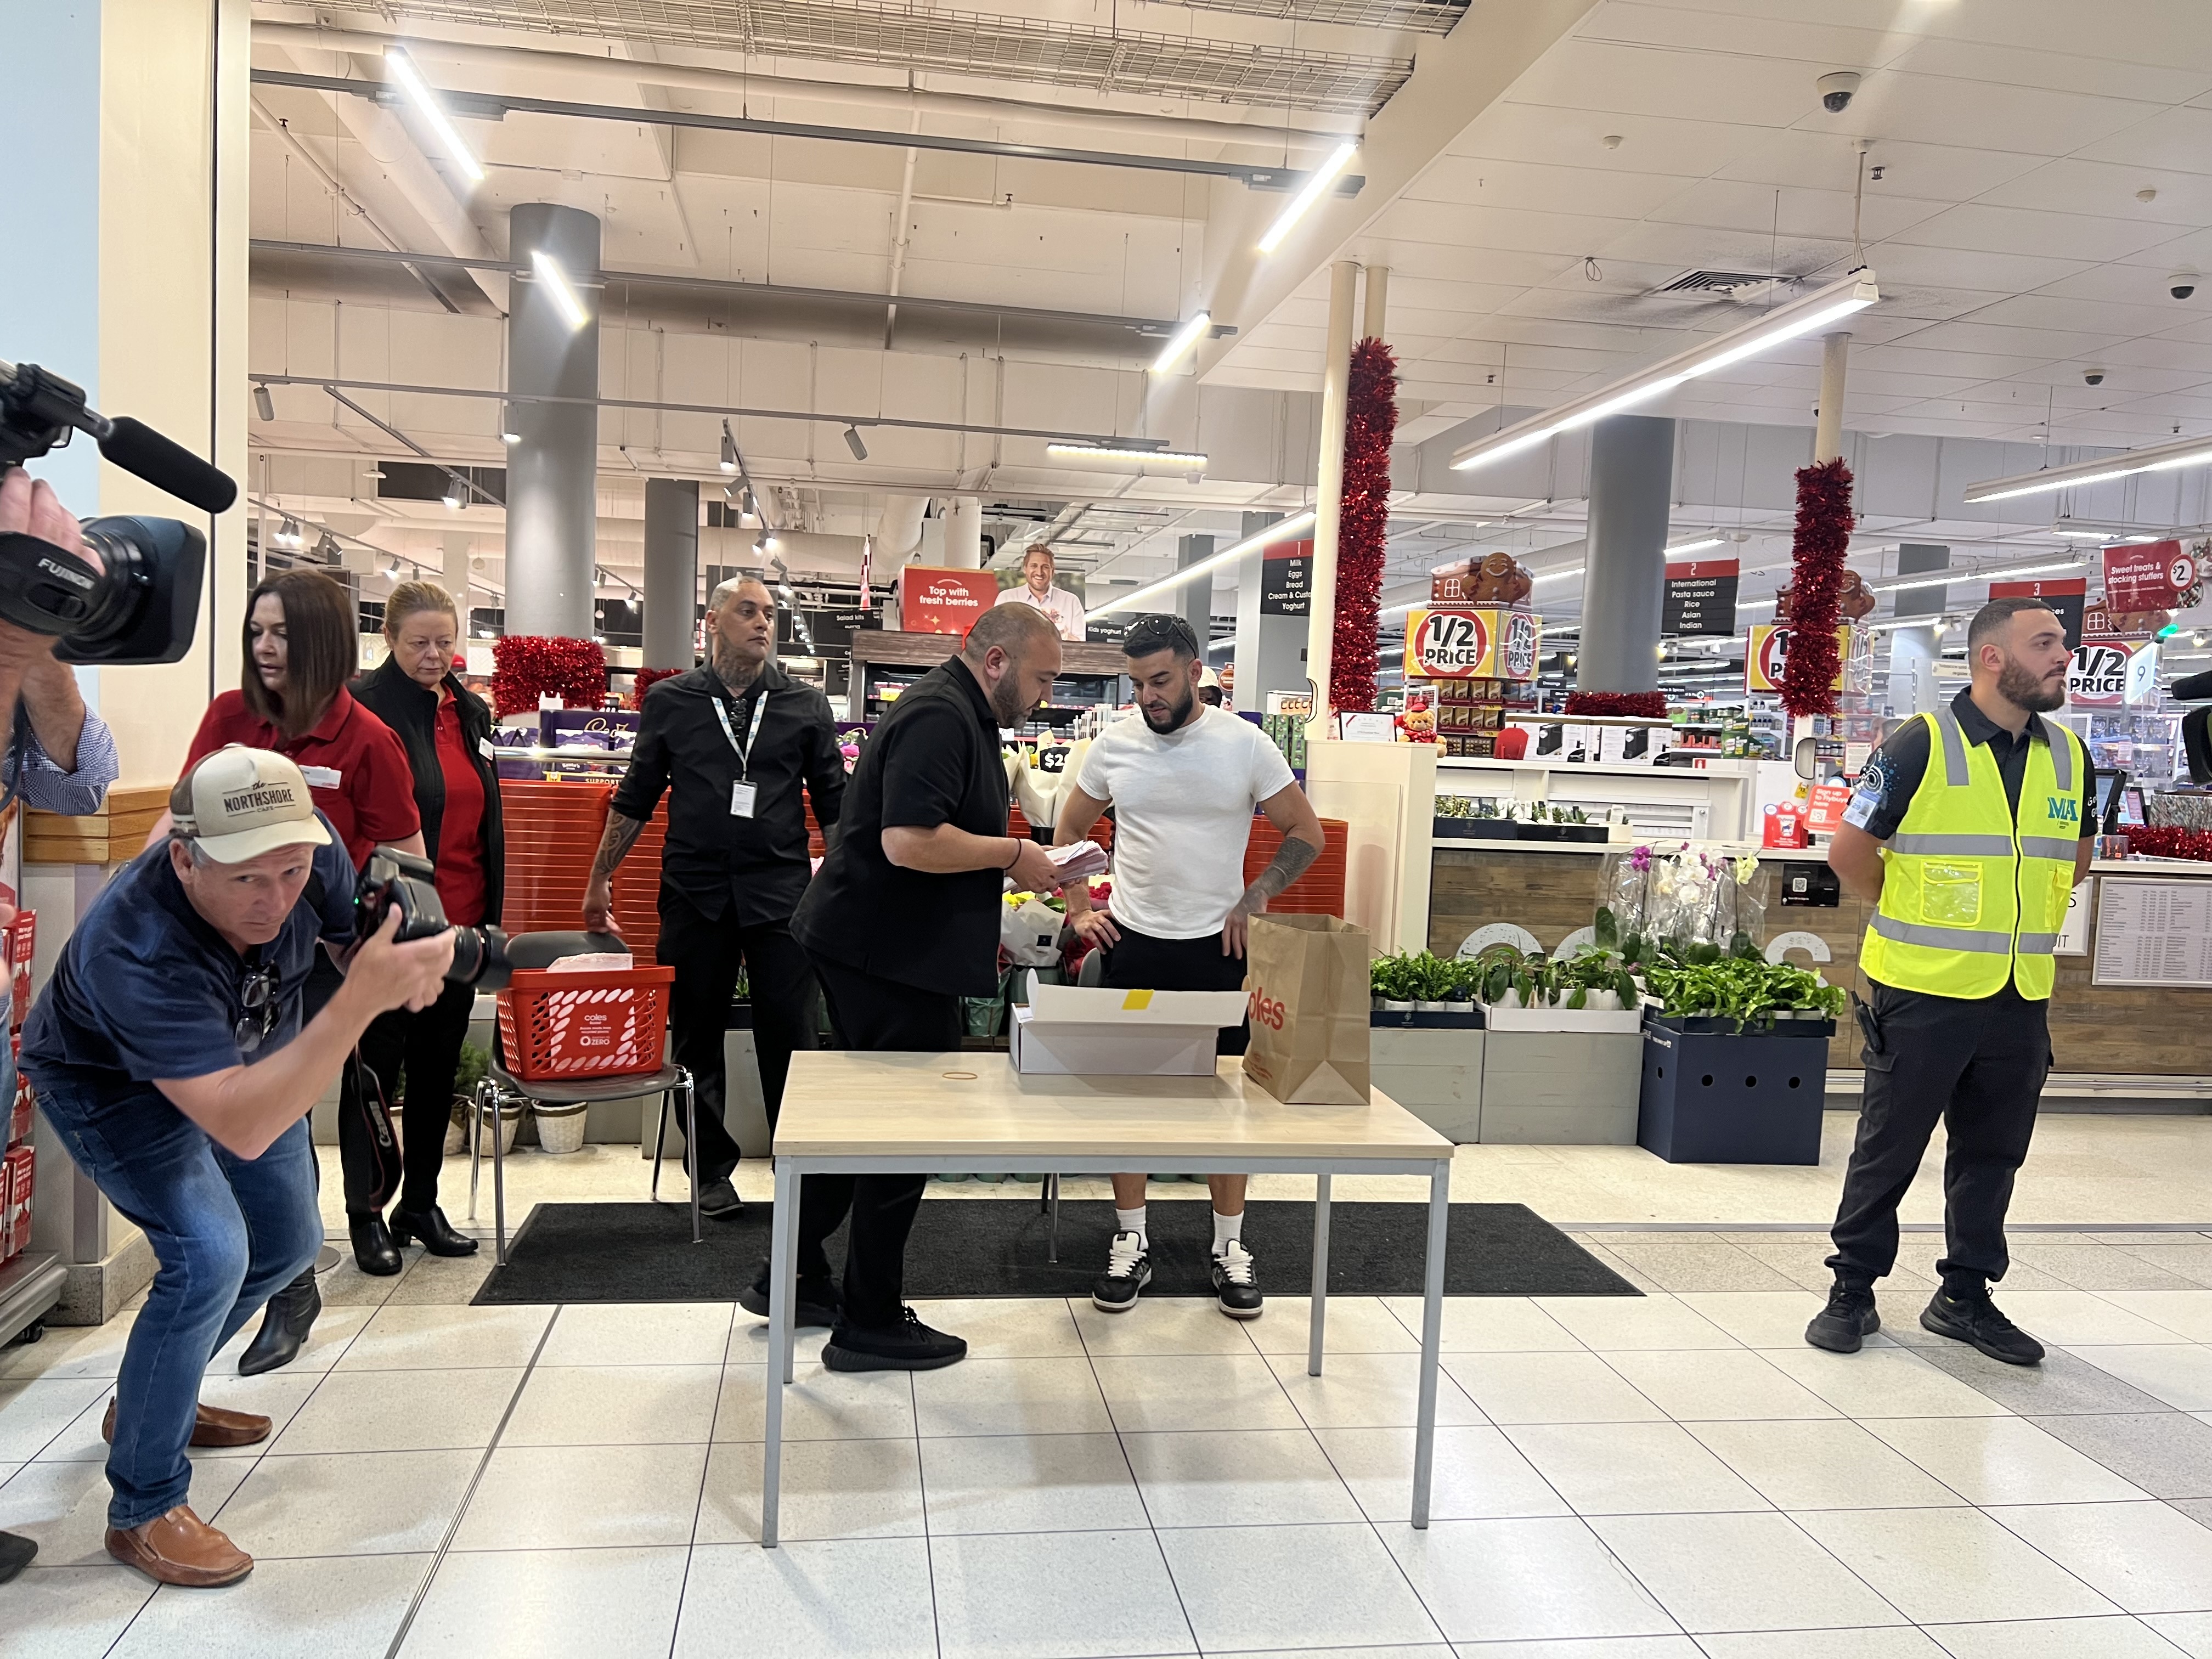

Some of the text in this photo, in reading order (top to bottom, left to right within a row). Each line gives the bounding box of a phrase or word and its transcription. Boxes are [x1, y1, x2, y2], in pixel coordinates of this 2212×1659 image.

[1297, 541, 1301, 555] 1
[1690, 562, 1697, 575] 2
[2111, 561, 2162, 574] Sweet treats &
[2172, 565, 2186, 581] $2
[1288, 571, 1302, 579] Eggs
[2108, 572, 2164, 584] stocking stuffers
[1285, 580, 1304, 589] Bread
[1671, 579, 1717, 588] International
[2033, 583, 2040, 596] 3
[929, 585, 969, 597] Top with
[1671, 590, 1691, 599] Pasta
[919, 595, 979, 607] fresh berries
[1282, 602, 1305, 611] Yoghurt
[1681, 611, 1701, 619] Asian
[1430, 616, 1474, 647] 1/2
[1424, 648, 1476, 664] PRICE
[2074, 647, 2124, 676] 1/2
[2137, 665, 2146, 682] 9
[2070, 678, 2124, 692] PRICE
[252, 780, 266, 791] the
[223, 788, 295, 812] NORTHSHORE
